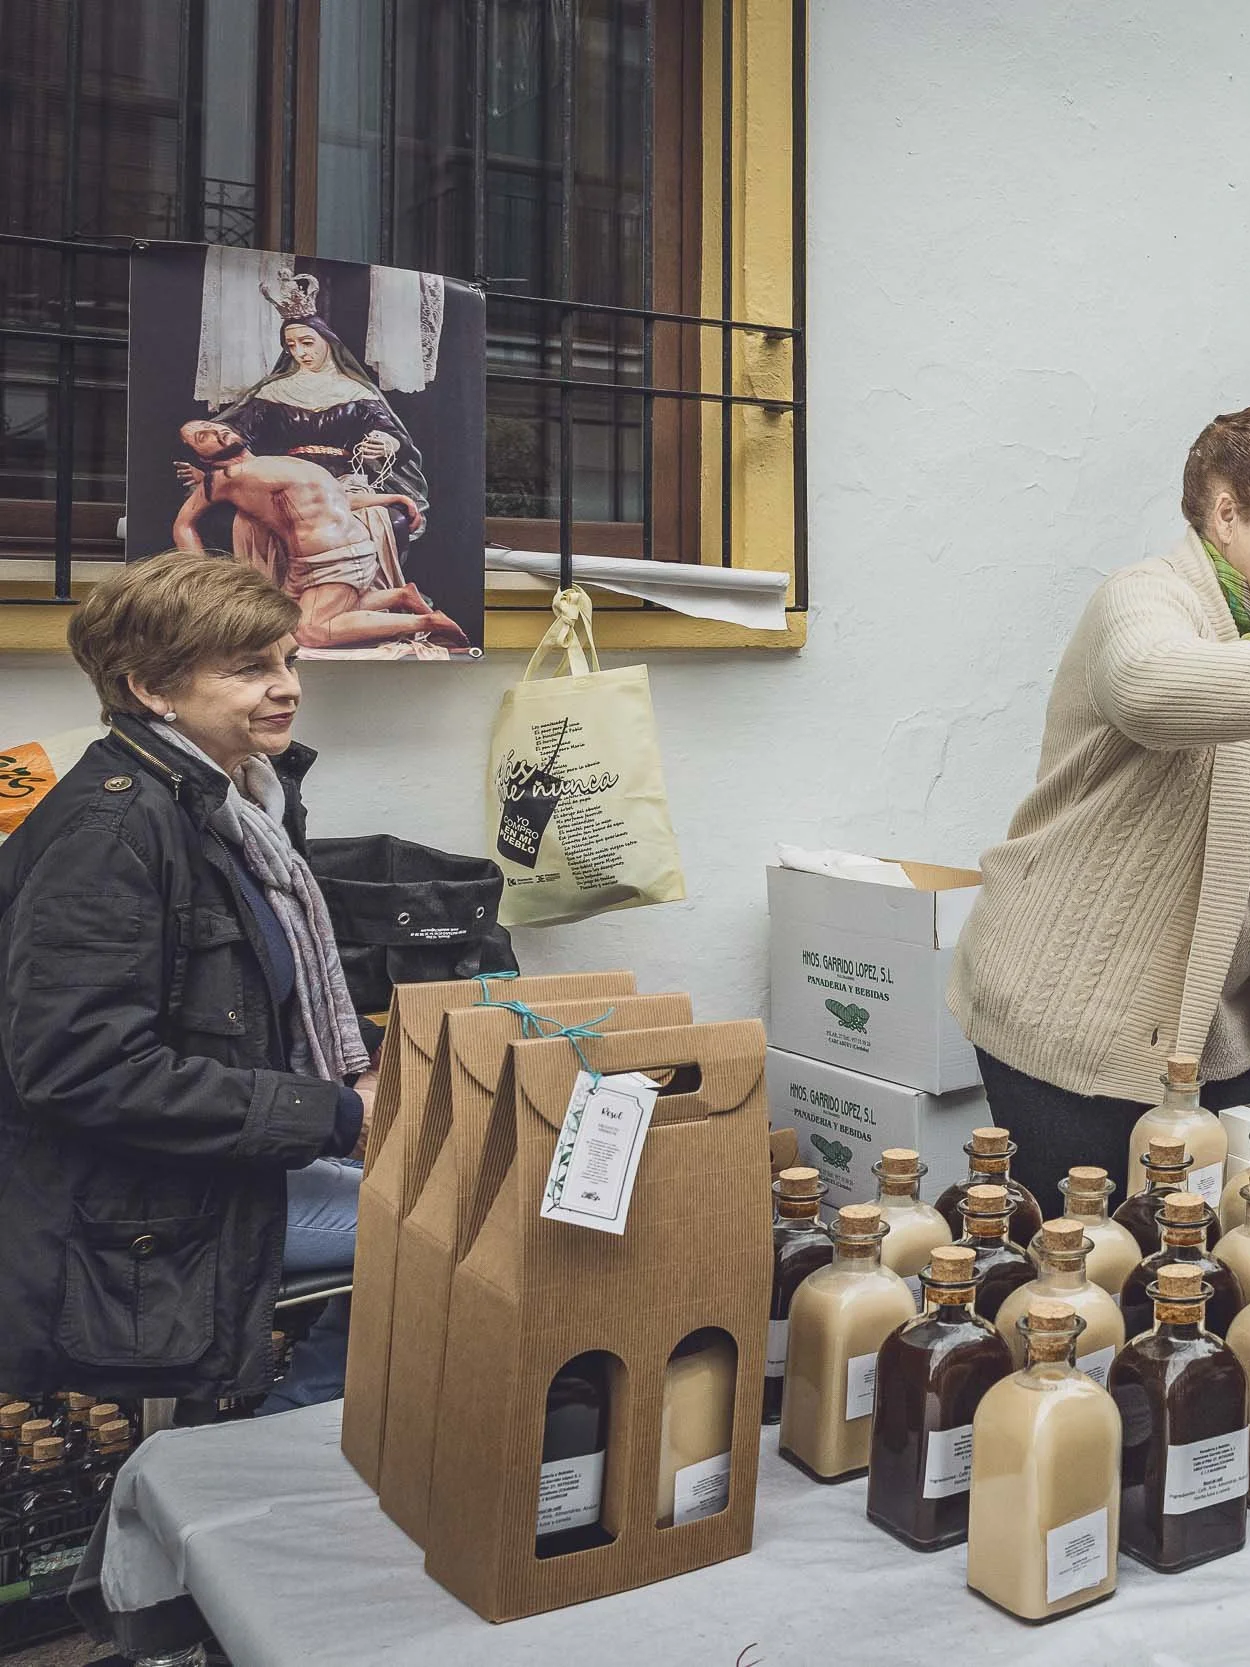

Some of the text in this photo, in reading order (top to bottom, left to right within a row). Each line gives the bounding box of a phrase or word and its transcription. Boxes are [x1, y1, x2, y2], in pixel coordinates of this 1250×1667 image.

[532, 772, 619, 799] nunca
[503, 815, 539, 840] COMPRO
[516, 815, 530, 826] YO
[500, 829, 536, 855] PUEBLO
[504, 825, 532, 845] EN MI
[823, 955, 854, 976] GARRIDO
[807, 975, 847, 992] PANADERIA
[848, 985, 854, 993] Y
[855, 986, 890, 1001] BEBIDAS
[810, 1089, 840, 1113] GARRIDO
[793, 1108, 832, 1128] PANADERIA
[833, 1122, 839, 1131] Y
[840, 1124, 872, 1143] BEBIDAS
